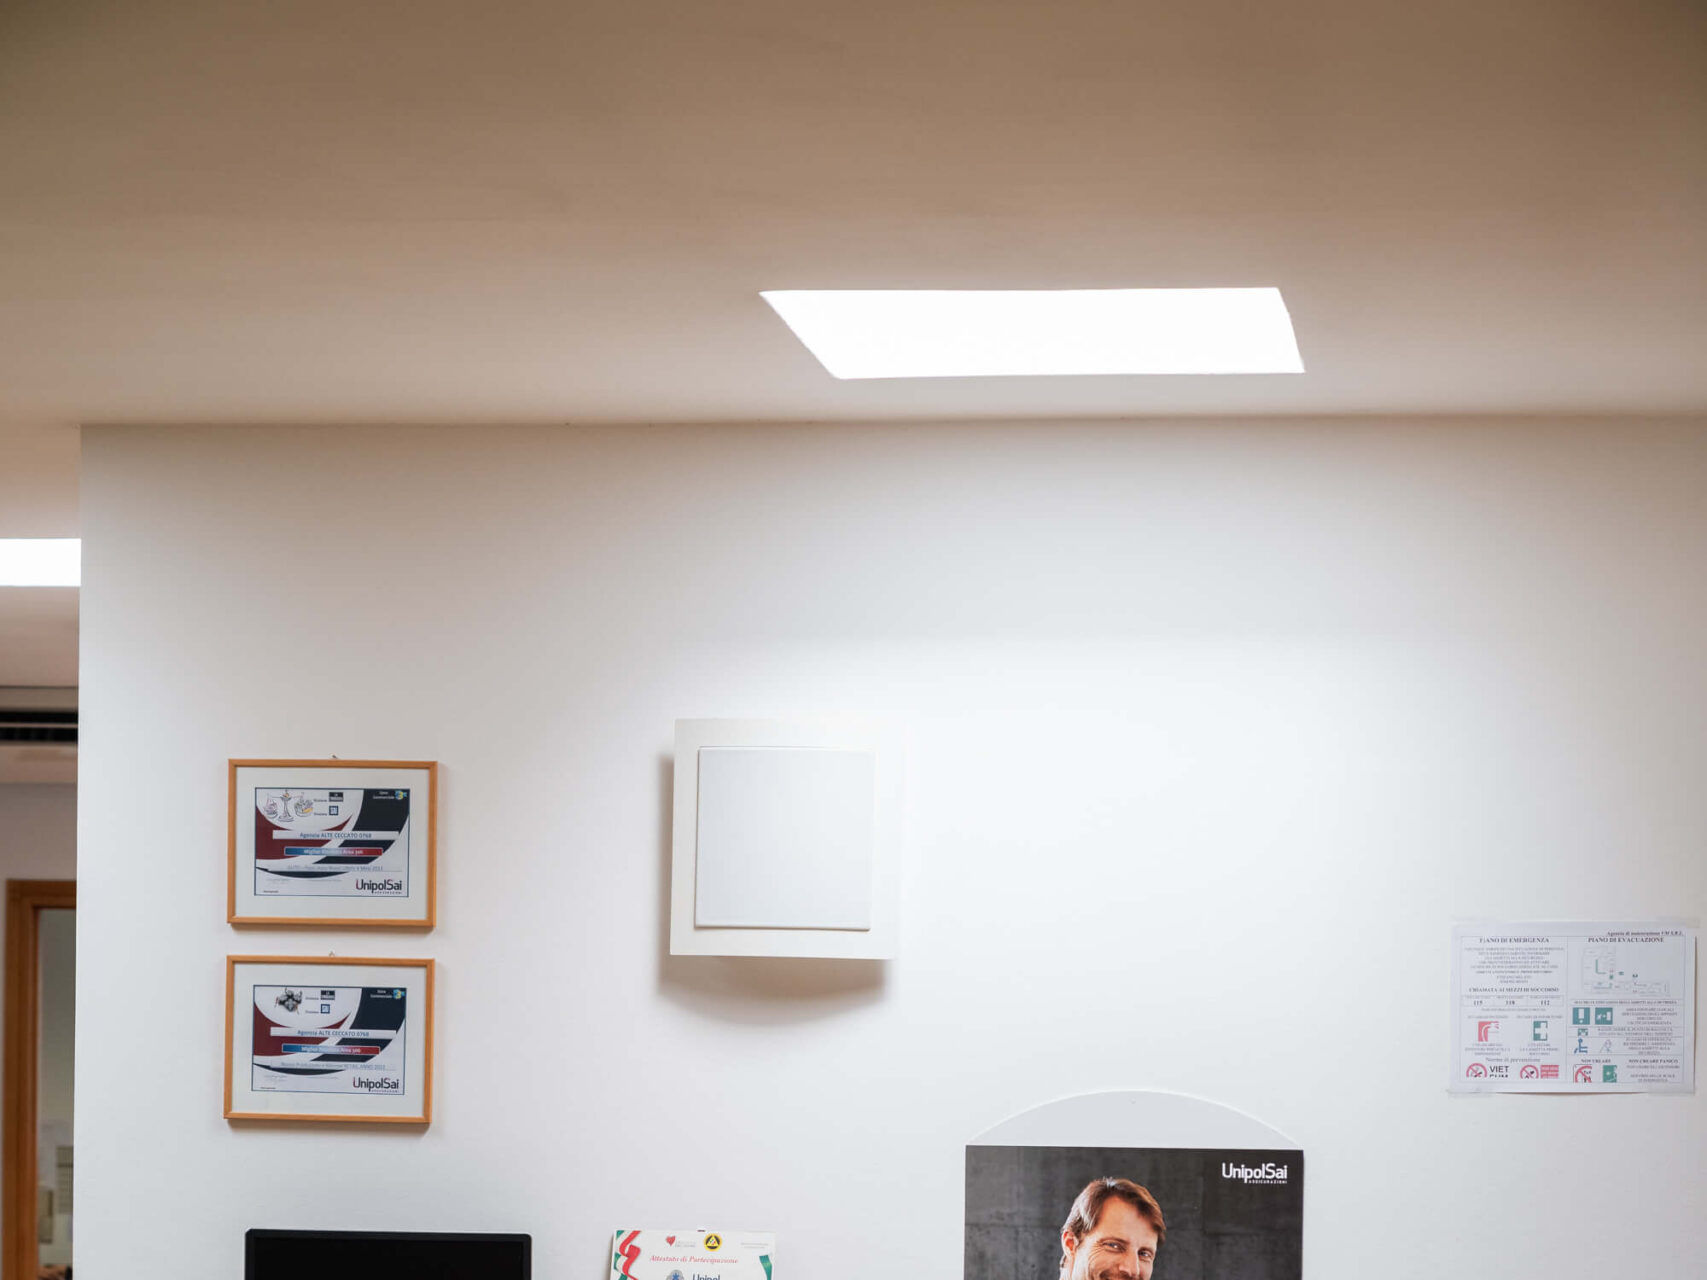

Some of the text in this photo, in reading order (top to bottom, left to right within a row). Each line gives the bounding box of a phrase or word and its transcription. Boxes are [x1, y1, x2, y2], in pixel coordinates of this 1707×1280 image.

[356, 879, 402, 893] UnipolSai
[353, 1078, 399, 1092] UnipolSai
[1222, 1162, 1288, 1184] UnipolSai
